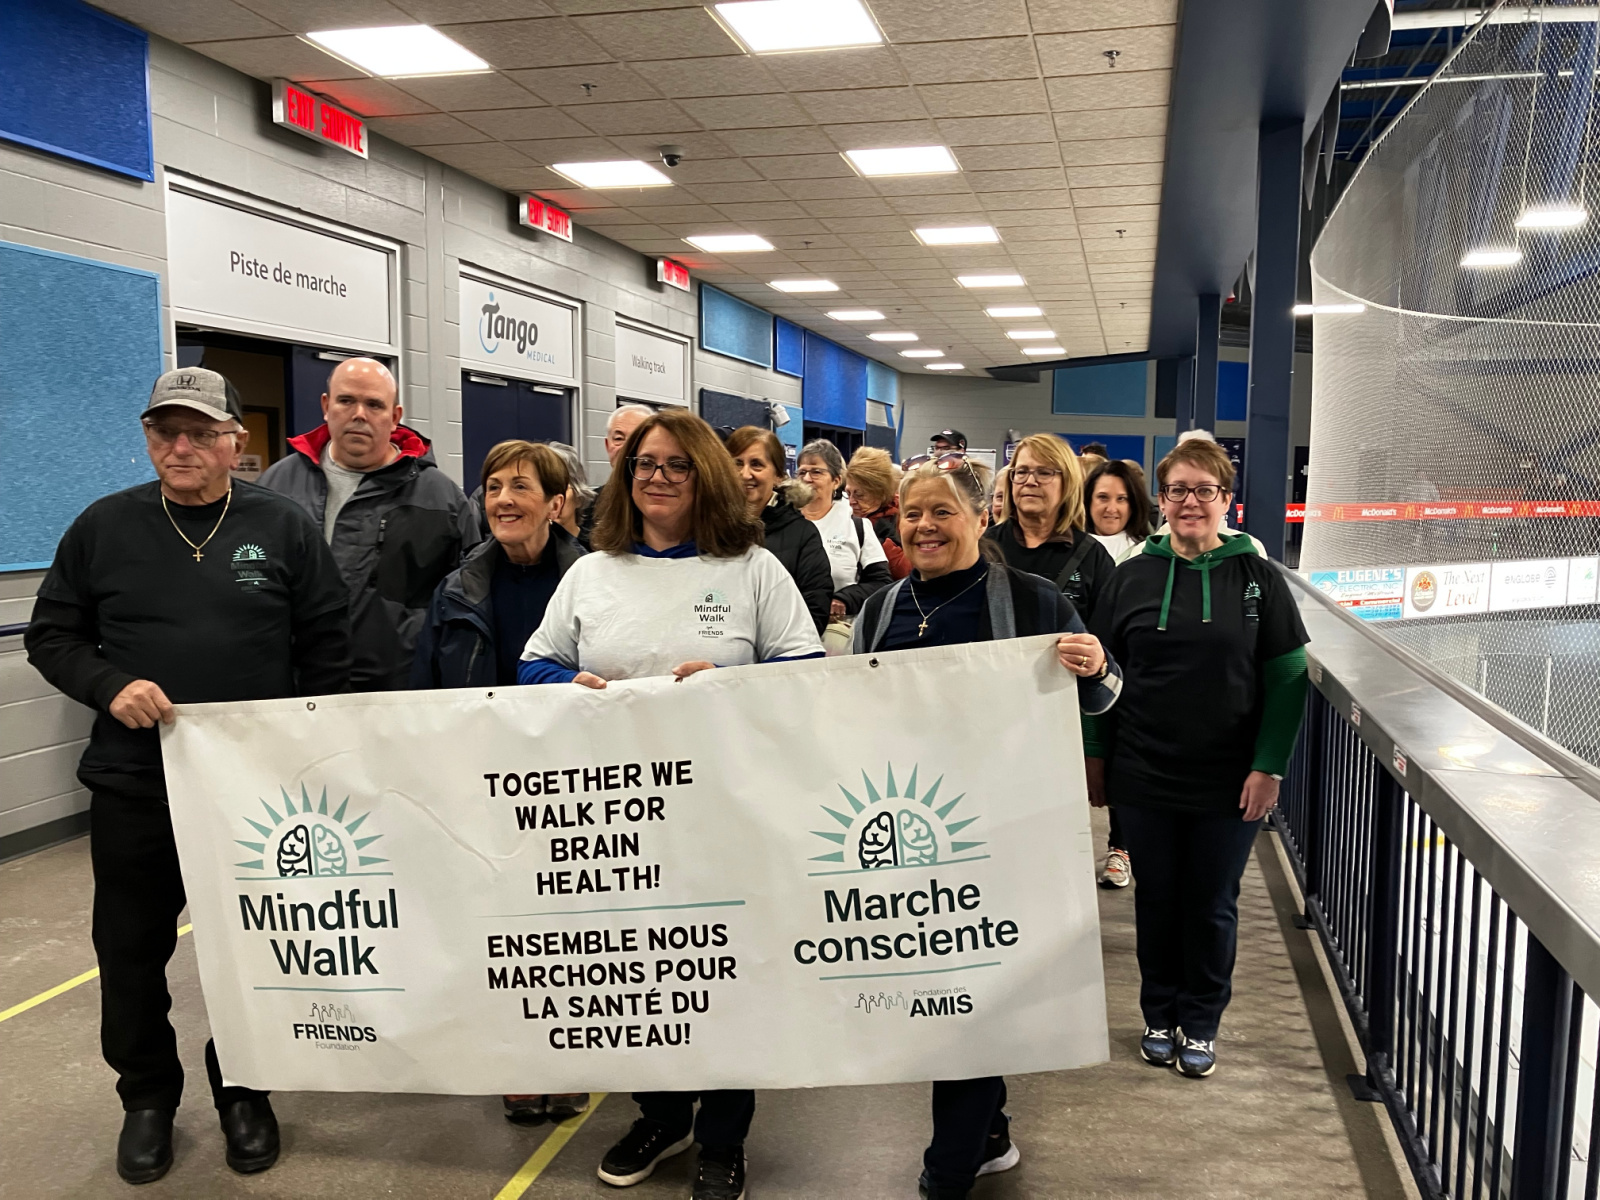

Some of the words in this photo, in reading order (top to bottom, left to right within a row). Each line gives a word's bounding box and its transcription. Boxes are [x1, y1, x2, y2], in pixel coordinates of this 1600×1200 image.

[287, 86, 315, 132] EXIT
[321, 103, 364, 154] SORTIE
[230, 250, 269, 280] Piste
[273, 261, 292, 285] de
[296, 275, 347, 298] marche
[481, 302, 539, 354] Tango
[526, 350, 555, 365] MEDICAL
[631, 354, 653, 375] Walking
[653, 361, 666, 374] track
[1338, 568, 1402, 582] EUGENE'S
[1443, 570, 1461, 586] The
[1463, 570, 1485, 584] Next
[694, 605, 731, 613] Mindful
[1446, 586, 1480, 607] Level
[699, 613, 725, 622] Walk
[484, 763, 643, 798] TOGETHER
[651, 760, 693, 787] WE
[515, 802, 596, 831] WALK
[605, 797, 666, 825] FOR
[551, 832, 640, 863] BRAIN
[537, 864, 661, 896] HEALTH!
[239, 889, 399, 932] Mindful
[824, 879, 981, 923] Marche
[270, 936, 380, 976] Walk
[488, 928, 639, 958] ENSEMBLE
[648, 924, 729, 951] NOUS
[794, 916, 1019, 965] consciente
[488, 961, 646, 990] MARCHONS
[655, 956, 737, 983] POUR
[523, 996, 560, 1020] LA
[568, 987, 663, 1018] SANTÉ
[672, 990, 710, 1014] DU
[909, 994, 974, 1018] AMIS
[913, 988, 952, 997] Fondation
[953, 986, 967, 994] des
[293, 1023, 378, 1043] FRIENDS
[315, 1041, 361, 1051] Foundation
[549, 1022, 691, 1050] CERVEAU!
